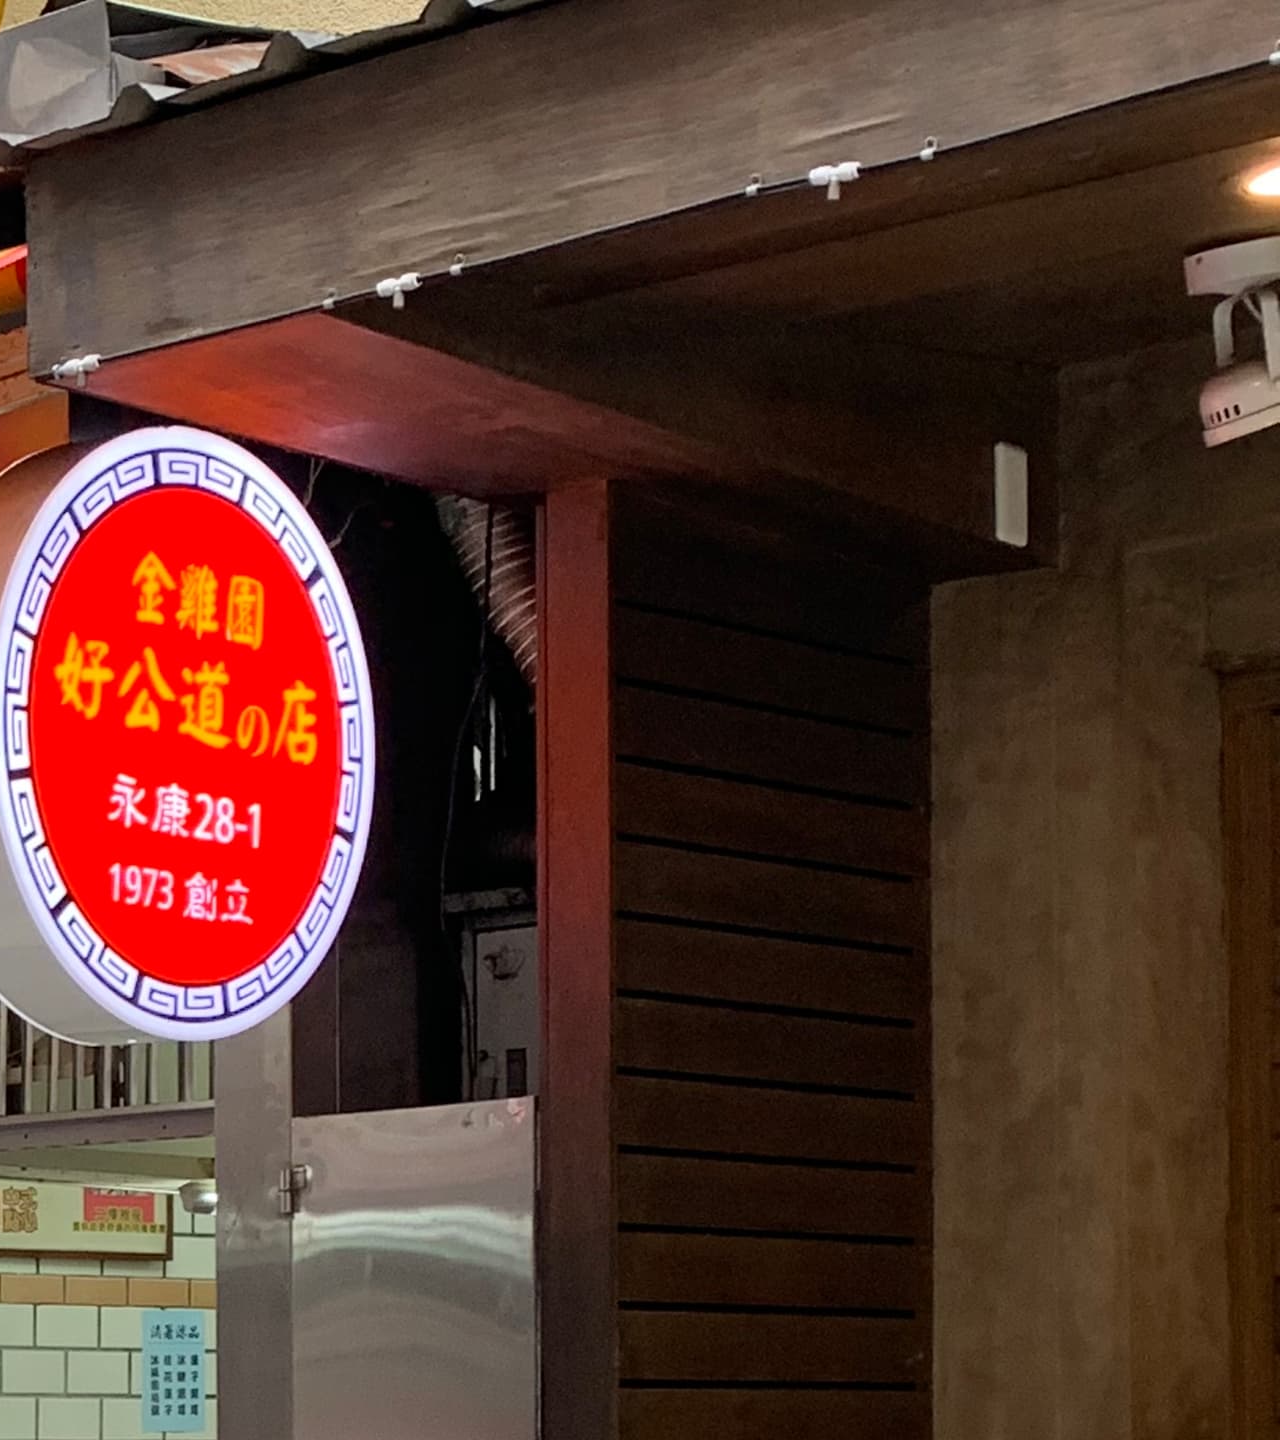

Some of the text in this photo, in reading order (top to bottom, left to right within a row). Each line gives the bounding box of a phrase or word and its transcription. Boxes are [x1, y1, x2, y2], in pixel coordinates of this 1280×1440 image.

[131, 550, 265, 651] 金雞園
[54, 631, 319, 766] 好公道の店
[107, 772, 262, 849] 永康28-1
[109, 862, 254, 925] 1973 創立
